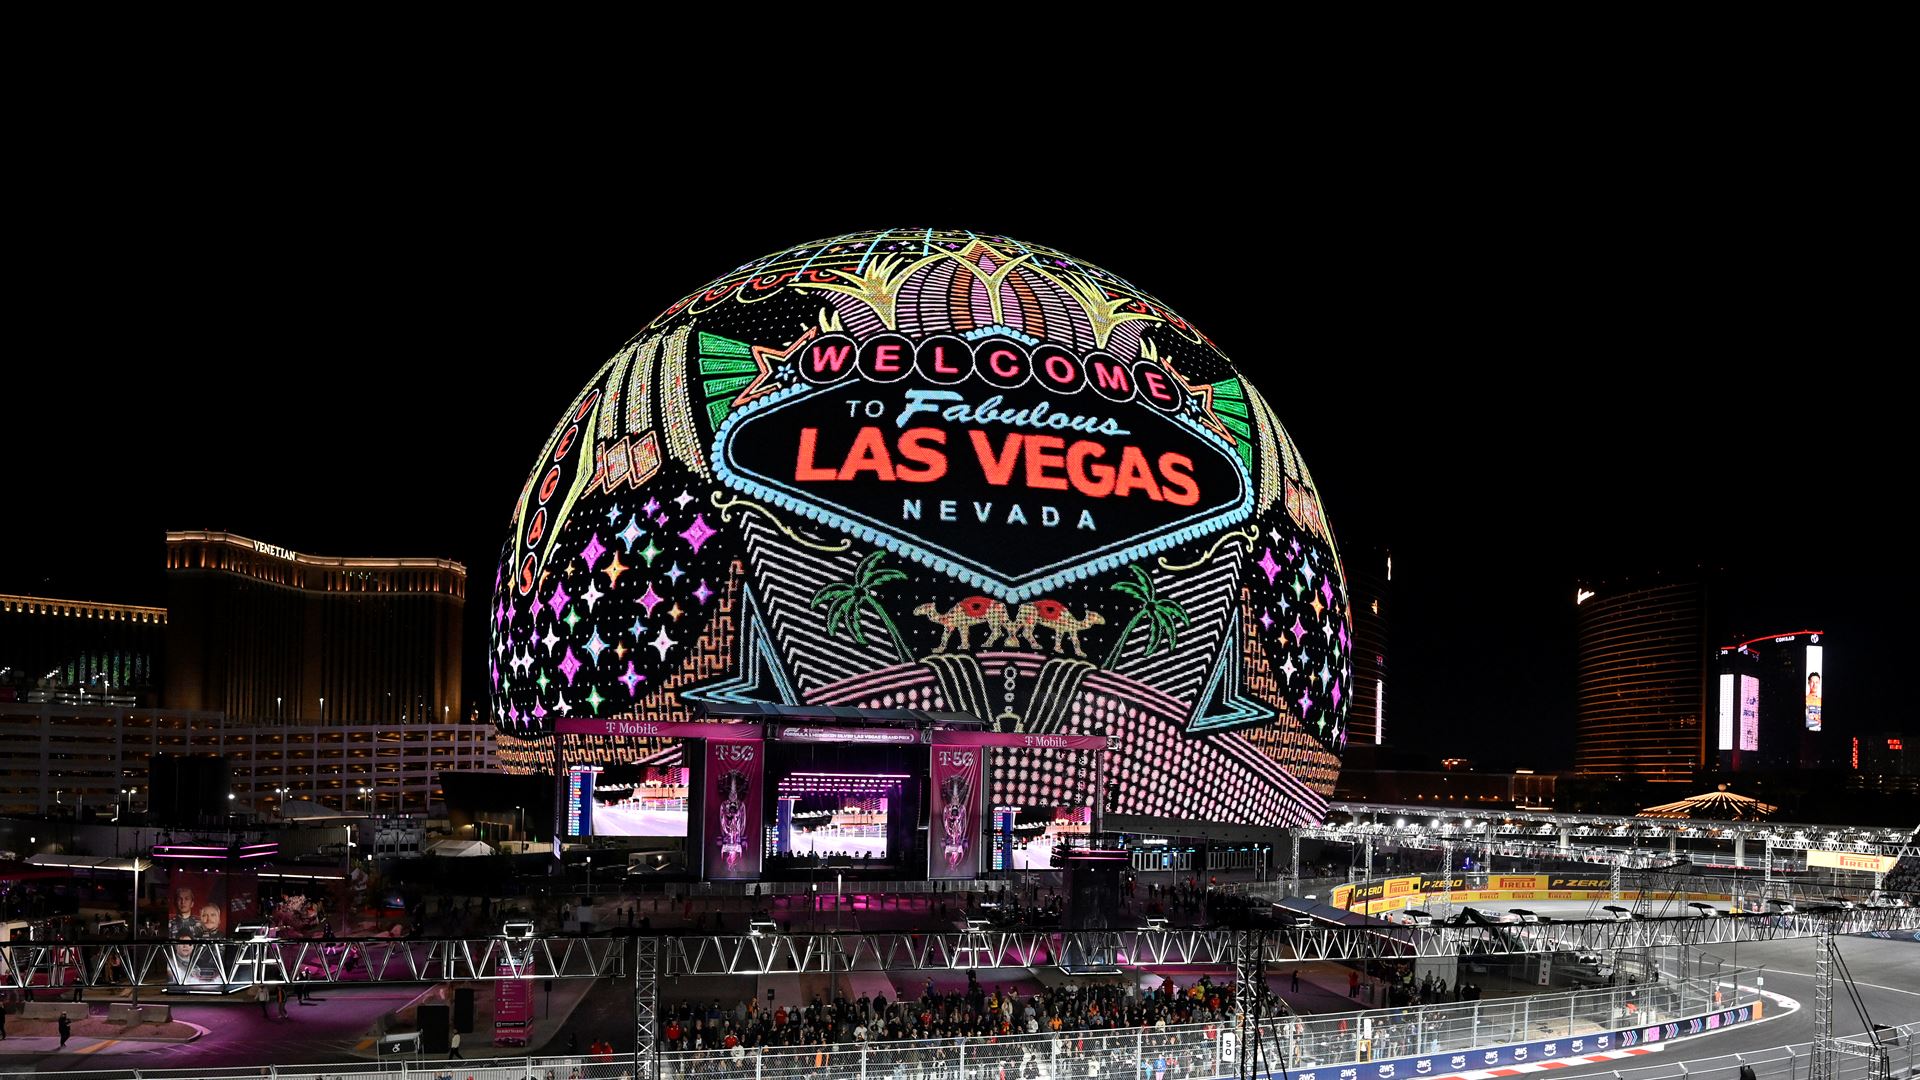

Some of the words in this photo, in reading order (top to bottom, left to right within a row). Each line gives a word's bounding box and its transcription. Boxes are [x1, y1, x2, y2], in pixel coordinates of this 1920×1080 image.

[811, 343, 1173, 402] WELCOME
[846, 400, 885, 419] TO
[896, 388, 1132, 436] Fabulous
[794, 426, 948, 482] LAS
[968, 429, 1201, 507] VEGAS
[902, 499, 1097, 531] NEVADA
[253, 539, 297, 561] VENETIAN
[619, 722, 659, 734] Mobile
[1035, 736, 1068, 747] Mobile
[730, 745, 755, 761] 5G
[952, 751, 974, 767] 5G
[1839, 855, 1880, 870] PIRELLI
[1421, 880, 1431, 889] P
[1499, 877, 1537, 888] PIRELLI
[1552, 879, 1564, 887] P
[1566, 879, 1611, 887] ZERO
[1298, 1072, 1316, 1080] aws
